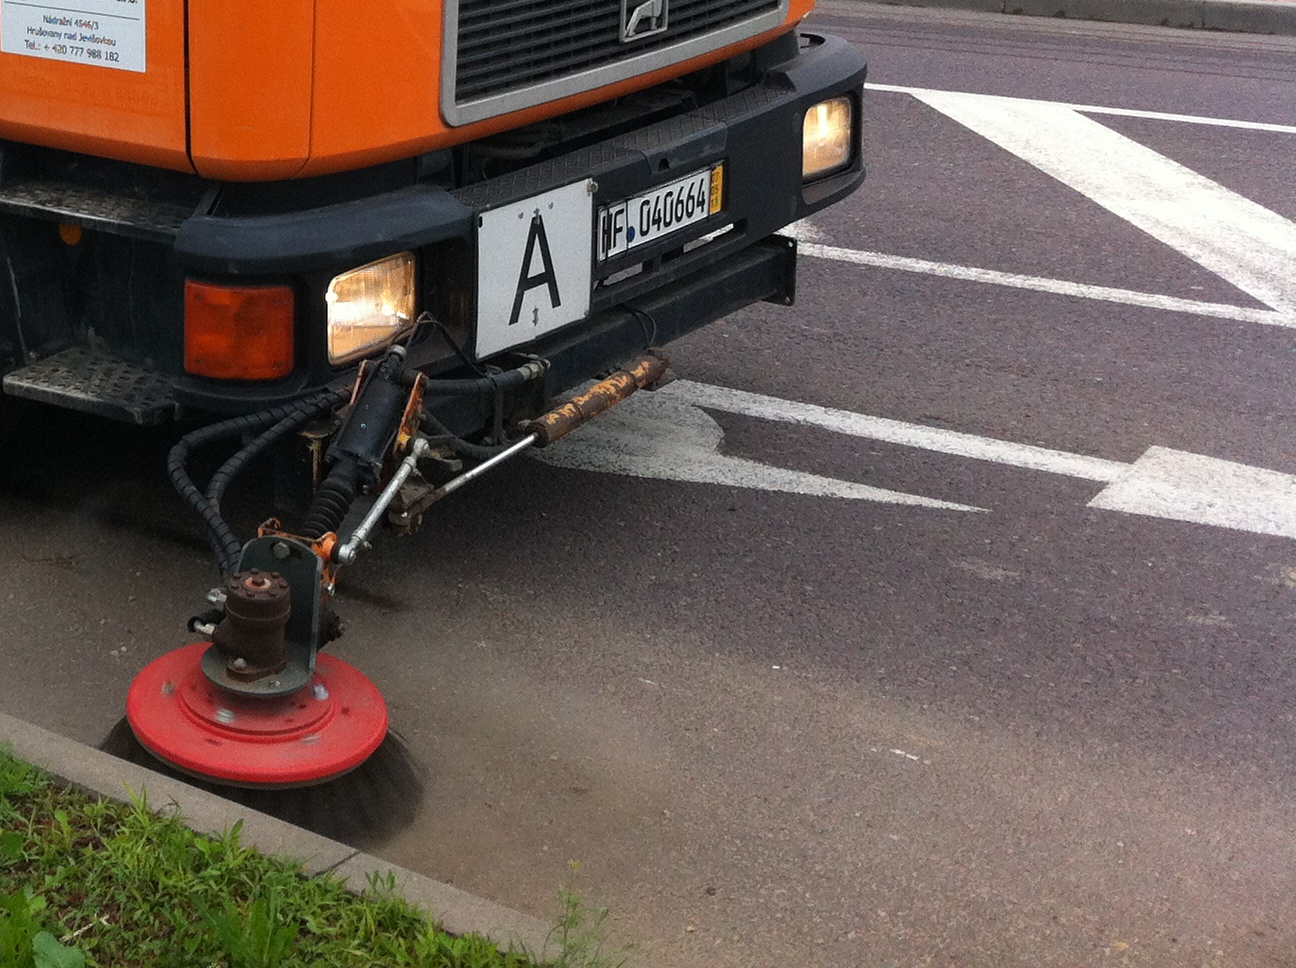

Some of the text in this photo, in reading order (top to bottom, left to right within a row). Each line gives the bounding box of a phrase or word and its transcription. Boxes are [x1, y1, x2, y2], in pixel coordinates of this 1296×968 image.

[63, 31, 77, 41] nad
[69, 45, 85, 57] 777
[104, 50, 120, 63] 182
[639, 177, 706, 238] 040664
[508, 213, 562, 326] A
